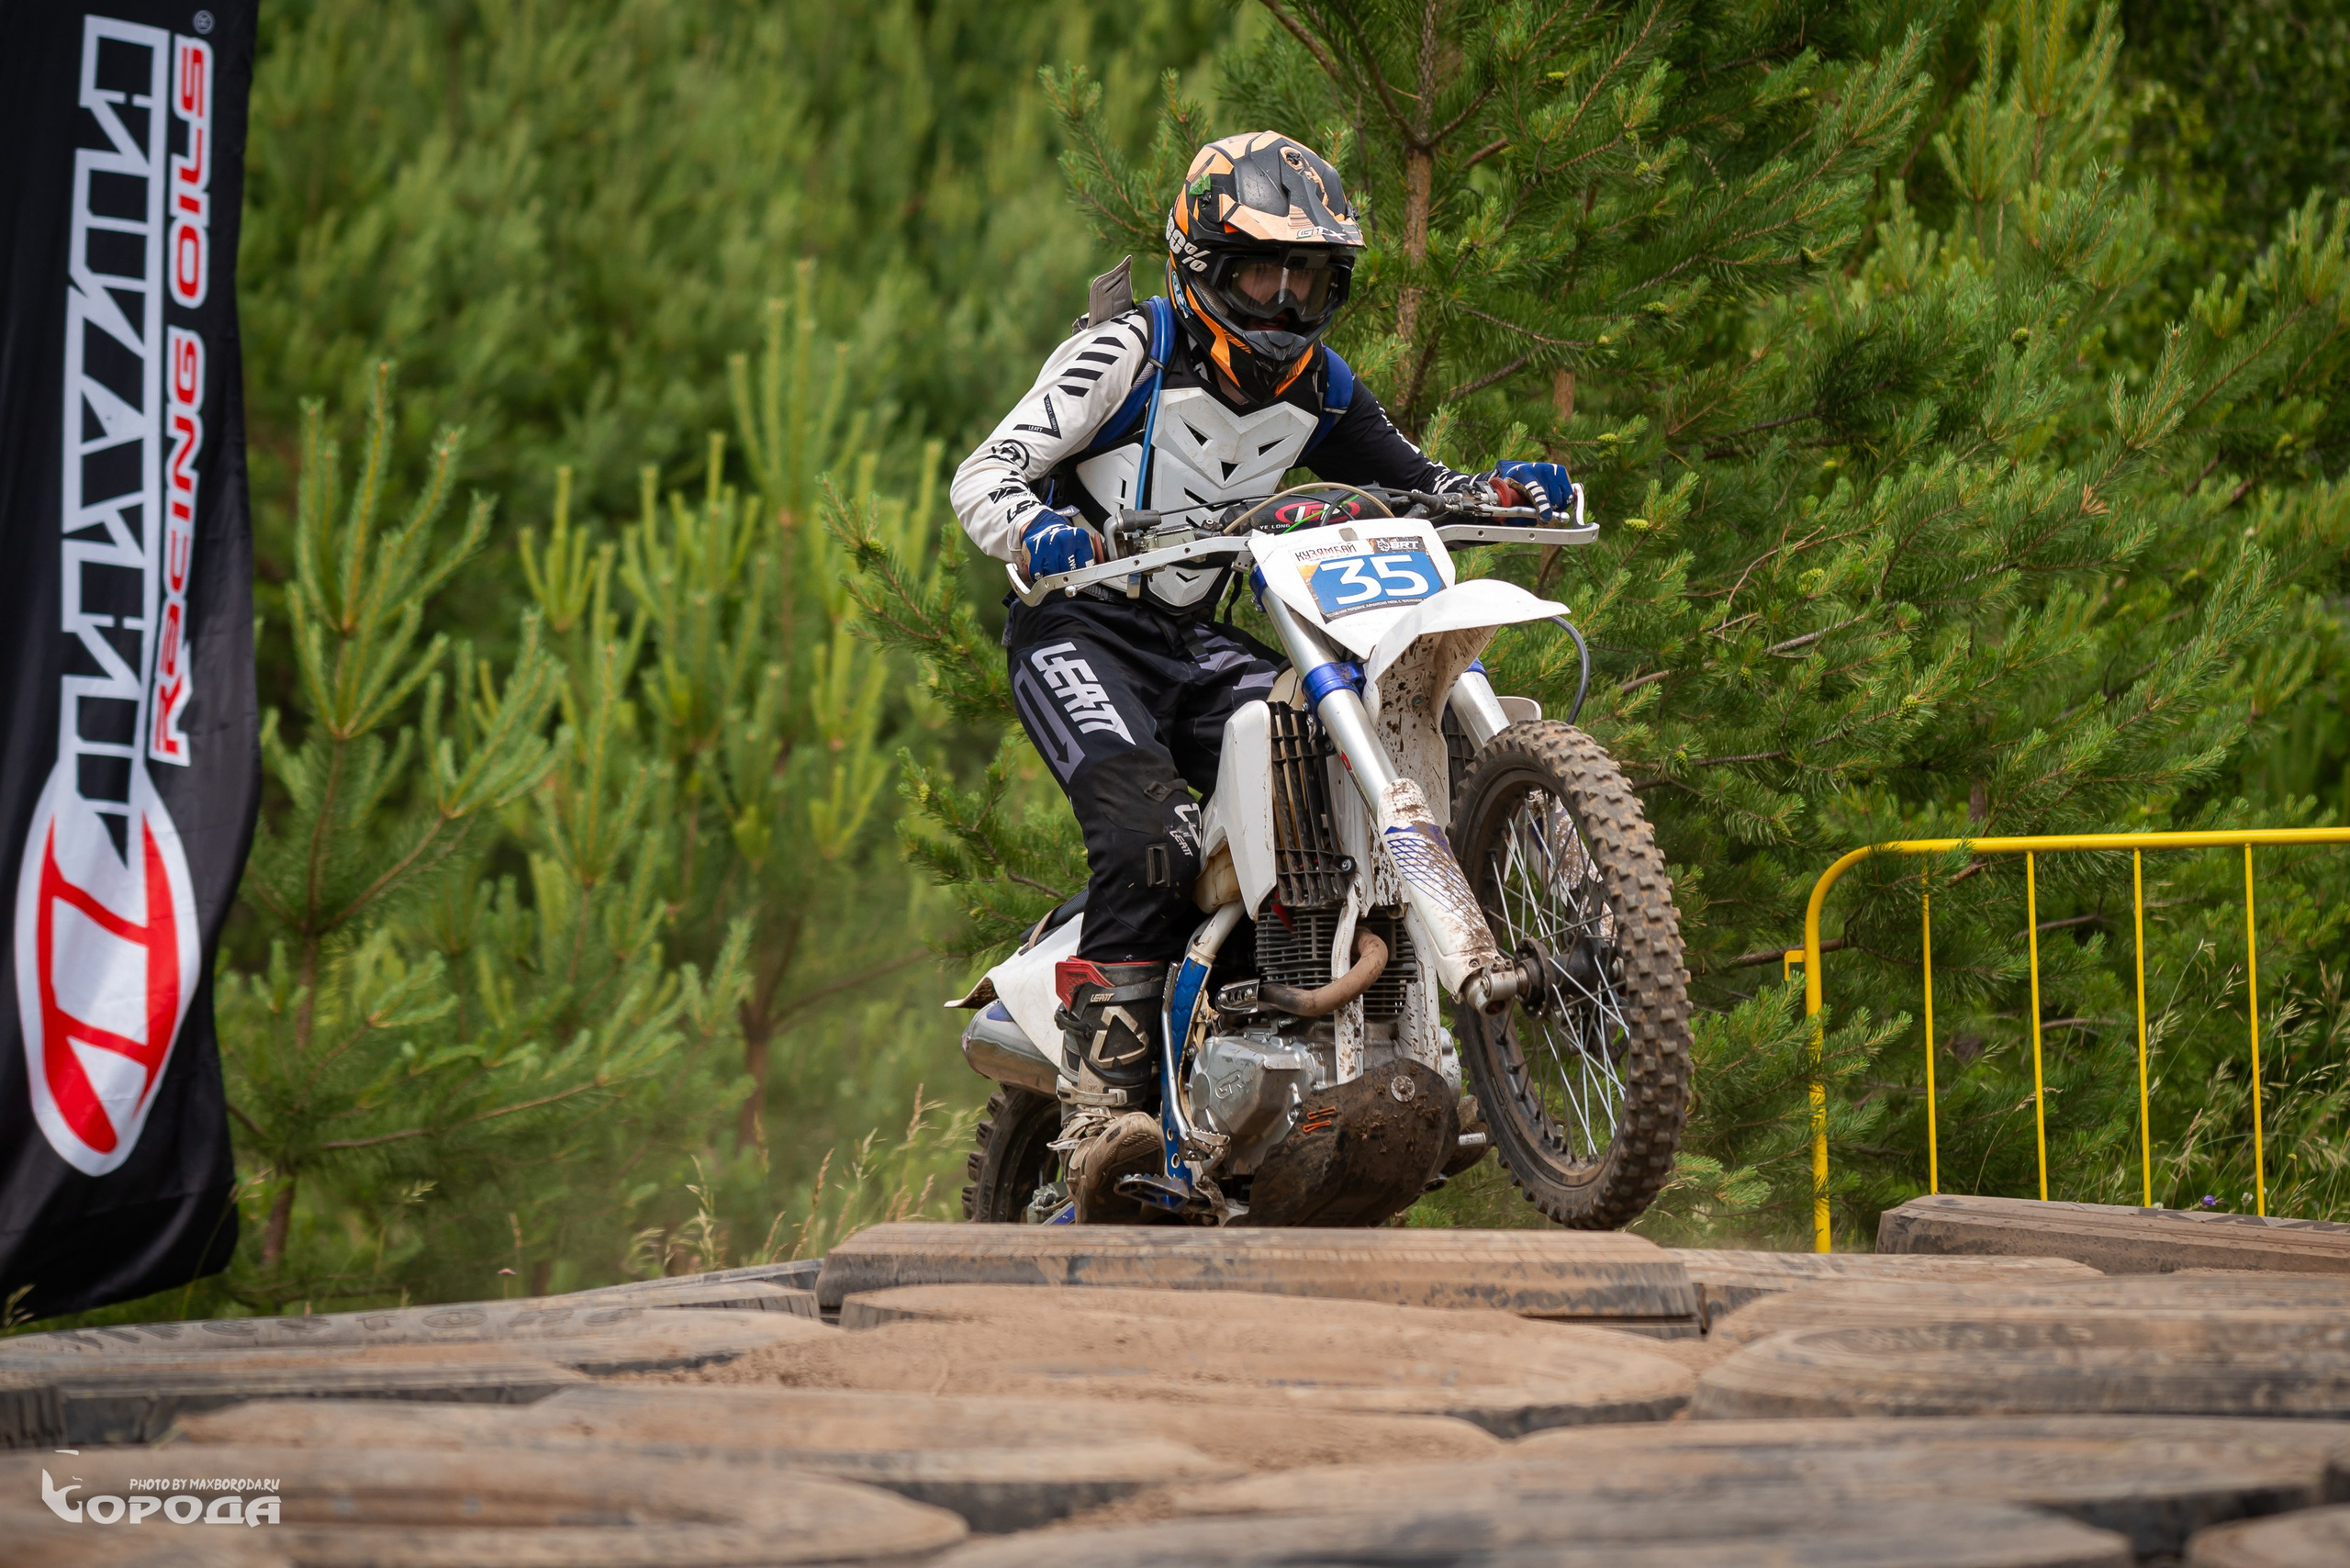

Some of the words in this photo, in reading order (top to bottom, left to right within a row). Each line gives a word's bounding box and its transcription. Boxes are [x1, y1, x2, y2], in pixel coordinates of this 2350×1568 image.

[171, 39, 209, 302] OILS
[1296, 226, 1346, 241] GTX
[1319, 554, 1429, 605] 35
[1030, 642, 1136, 745] LEATT
[1169, 830, 1193, 857] LEATT
[1090, 992, 1114, 1002] LEATT
